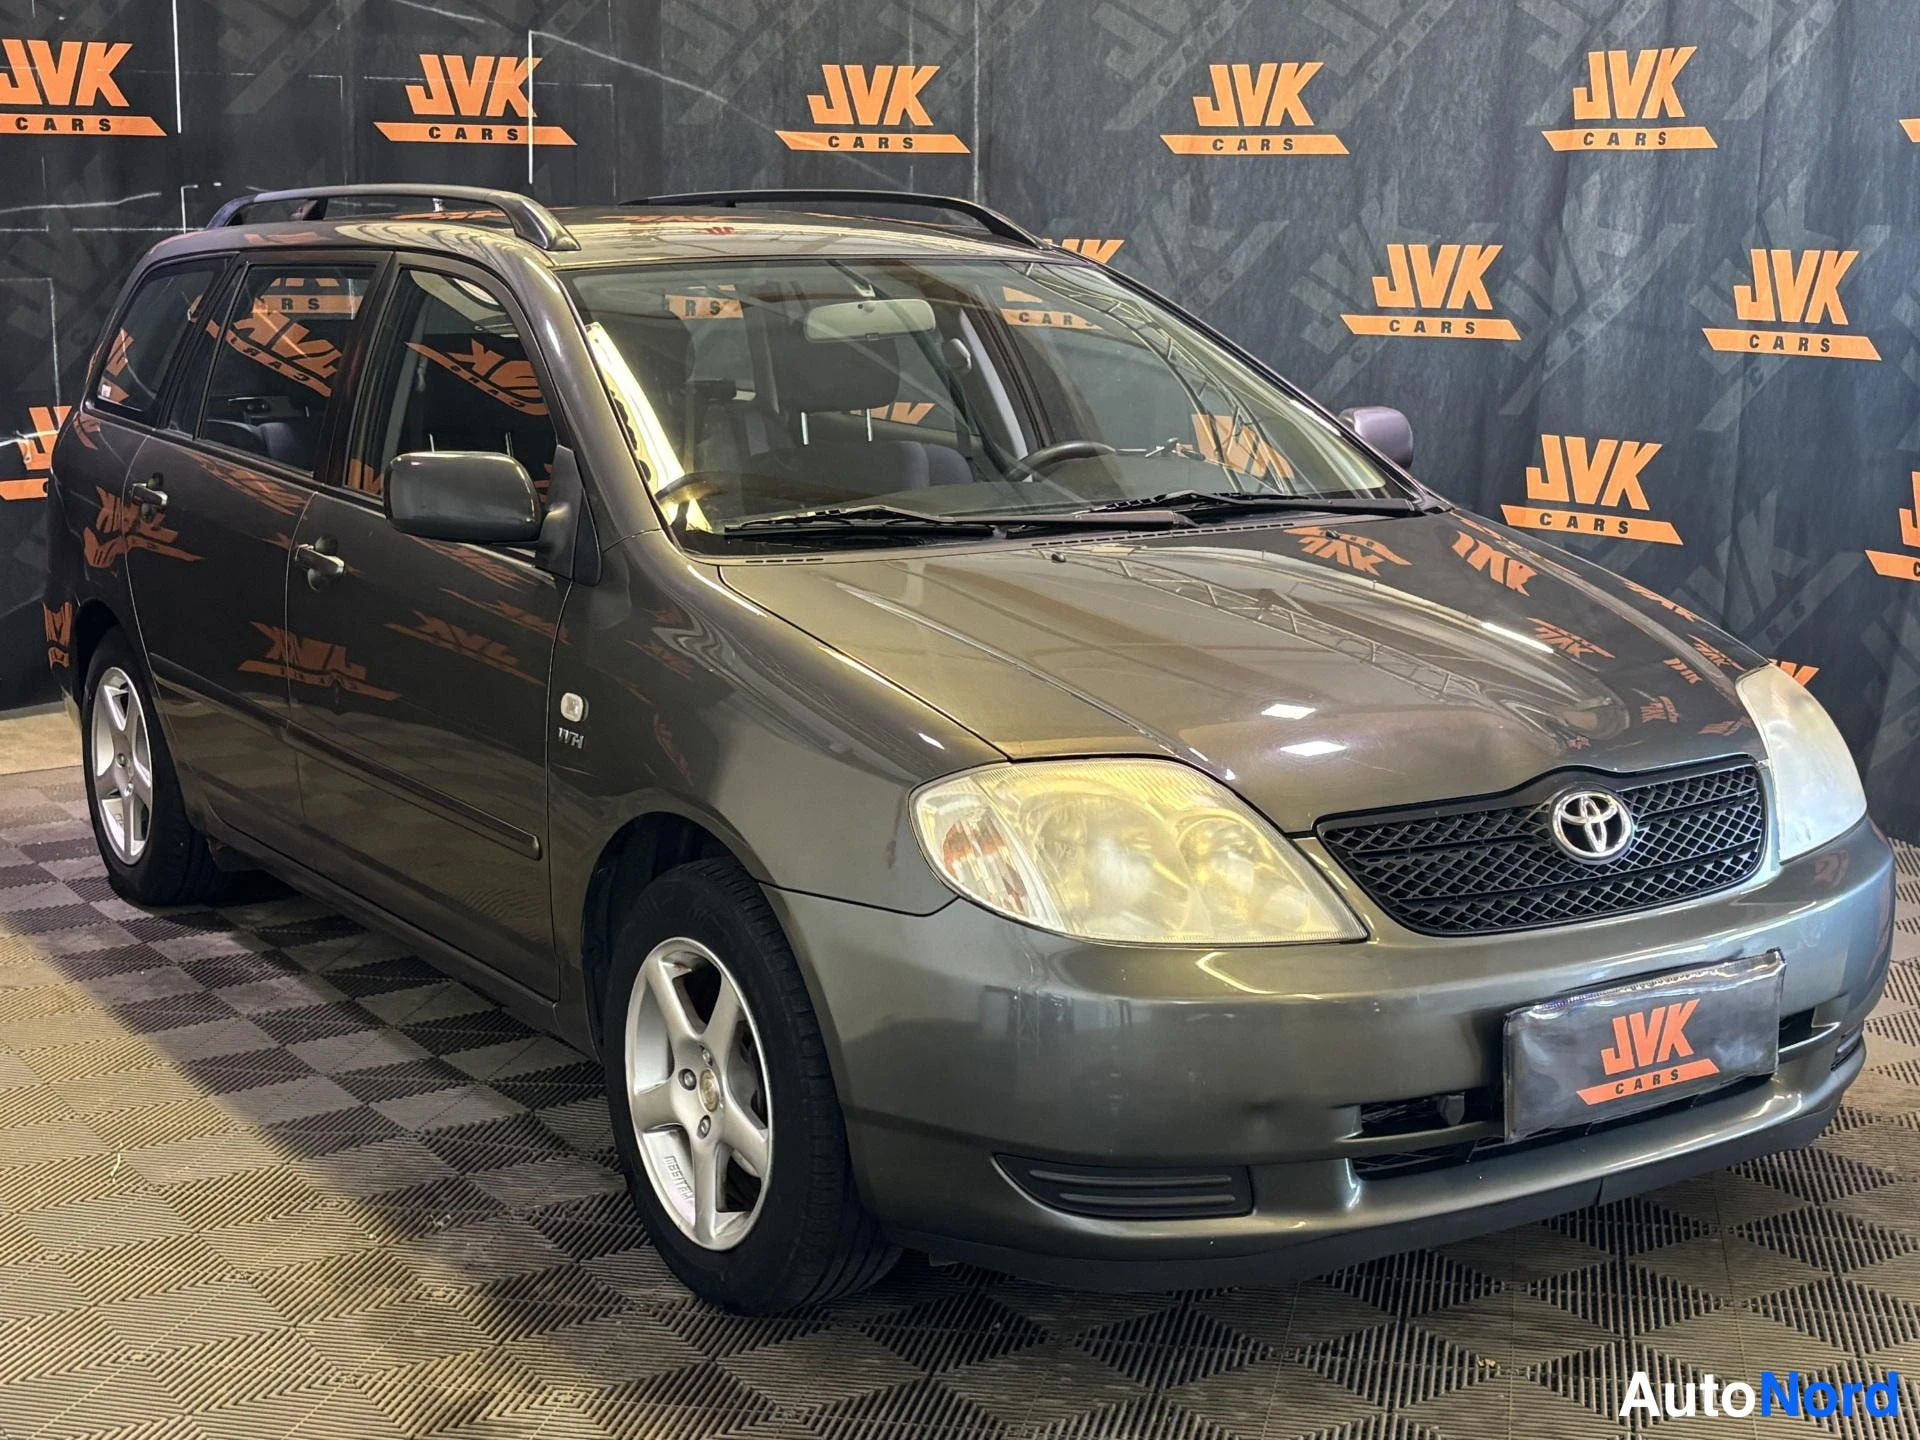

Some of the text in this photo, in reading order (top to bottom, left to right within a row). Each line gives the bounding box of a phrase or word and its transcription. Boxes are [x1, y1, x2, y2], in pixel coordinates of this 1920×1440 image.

[0, 40, 133, 107] JVK
[405, 55, 543, 118] JVK
[1573, 47, 1697, 119] JVK
[807, 65, 940, 126] JVK
[1193, 62, 1324, 126] JVK
[15, 117, 112, 132] CARS
[428, 126, 519, 141] CARS
[1583, 131, 1667, 146] CARS
[827, 135, 914, 149] CARS
[1211, 138, 1294, 151] CARS
[1372, 244, 1503, 310] JVK
[1733, 248, 1859, 325] JVK
[1018, 311, 1092, 327] CAR
[1388, 319, 1476, 335] CARS
[1749, 334, 1830, 353] CARS
[1525, 434, 1663, 511] JVK
[1539, 513, 1629, 535] CARS
[1601, 998, 1699, 1075] JVK
[1615, 1068, 1680, 1096] CARS
